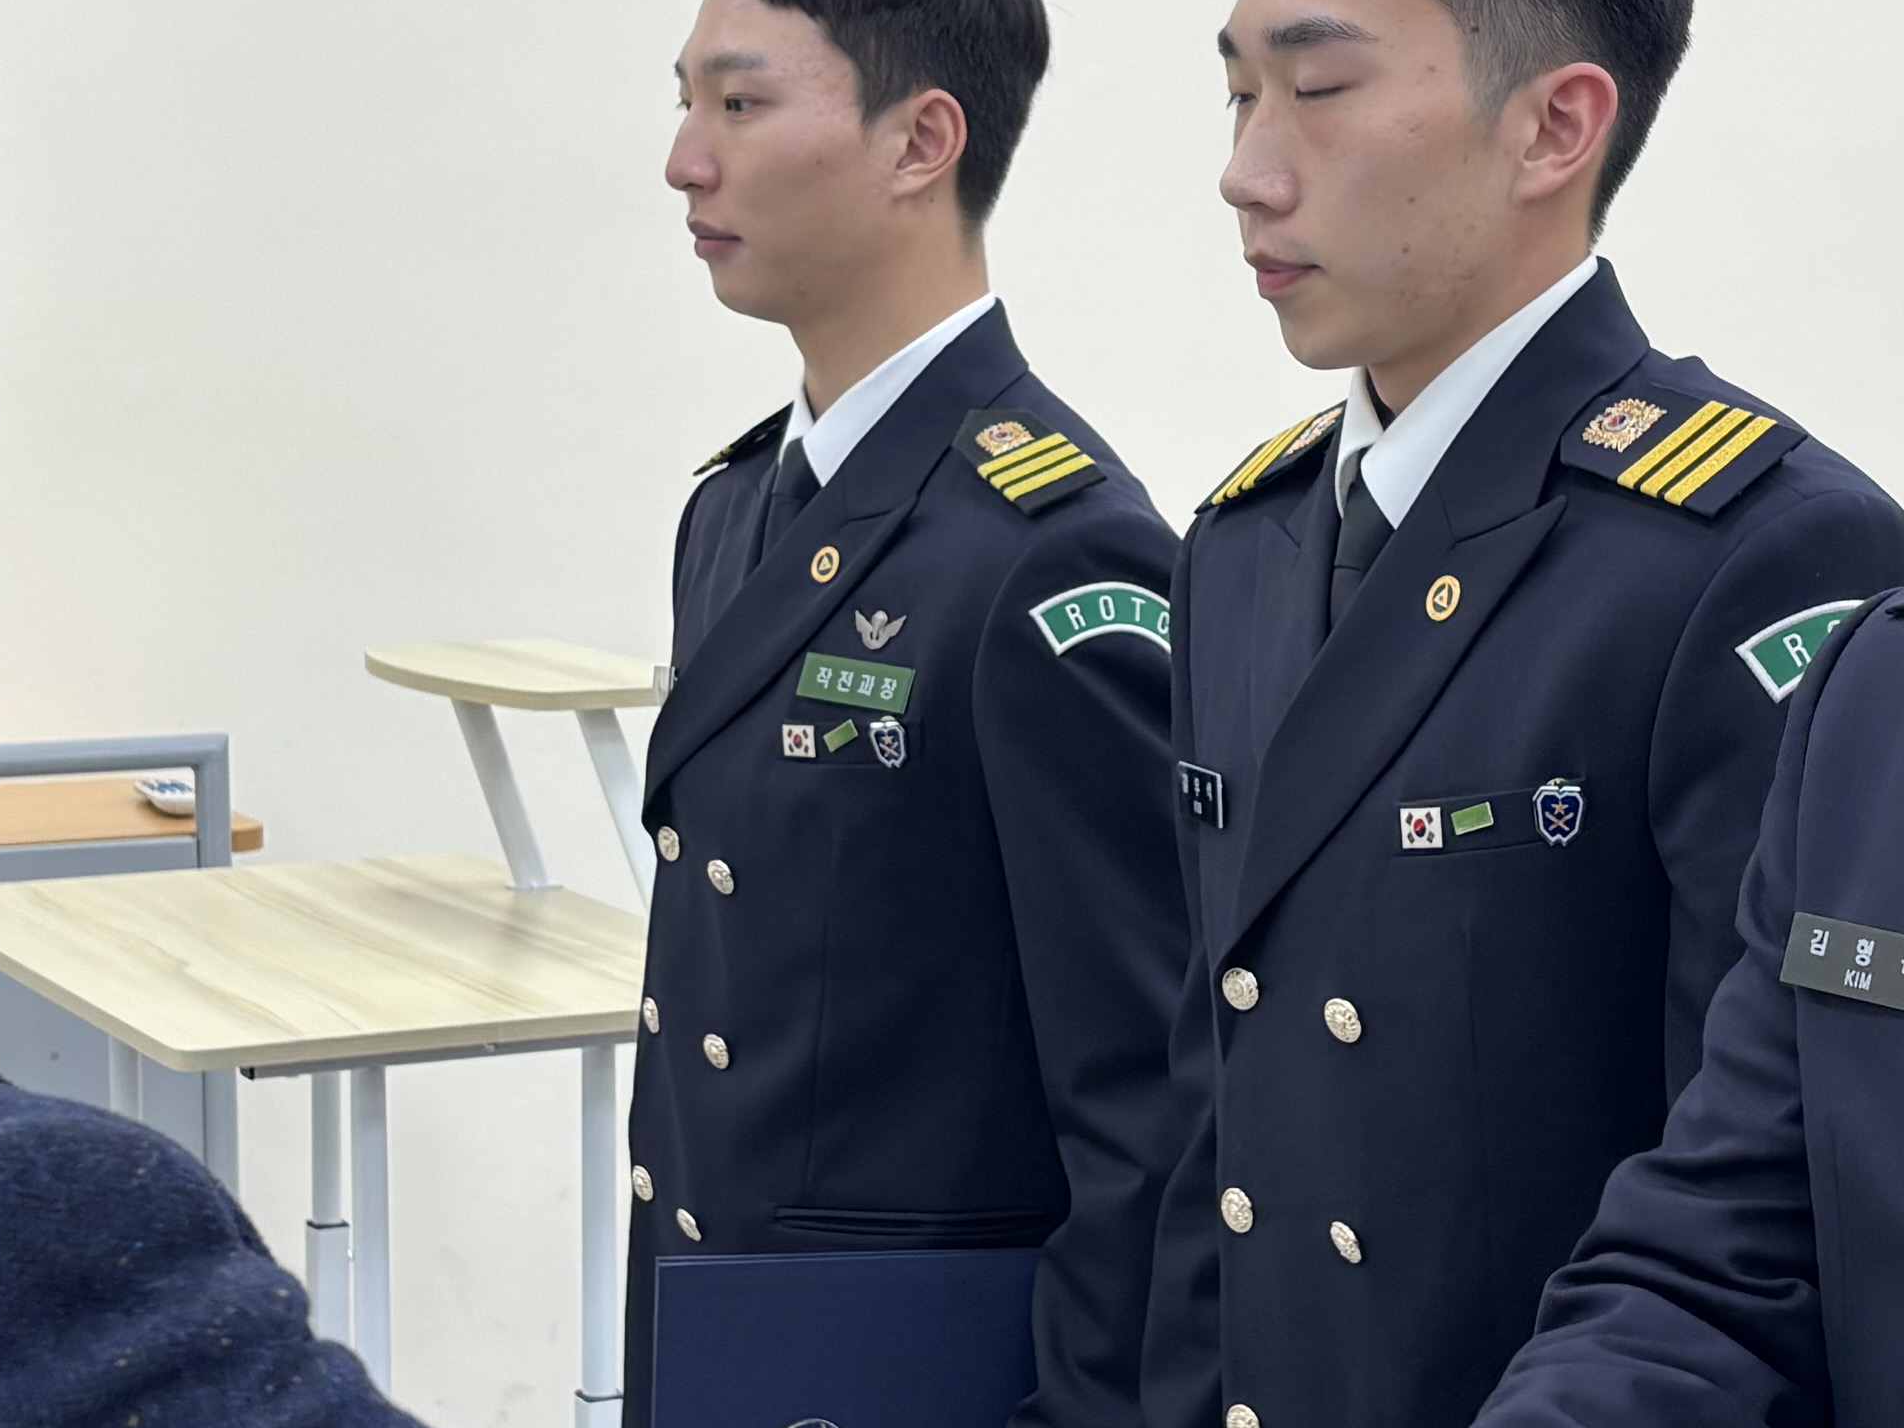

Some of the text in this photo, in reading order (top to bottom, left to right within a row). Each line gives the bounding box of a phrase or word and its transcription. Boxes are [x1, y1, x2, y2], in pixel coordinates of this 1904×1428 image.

[1064, 594, 1170, 635] ROTC
[816, 666, 898, 700] 작전과장
[1844, 968, 1873, 991] KIM
